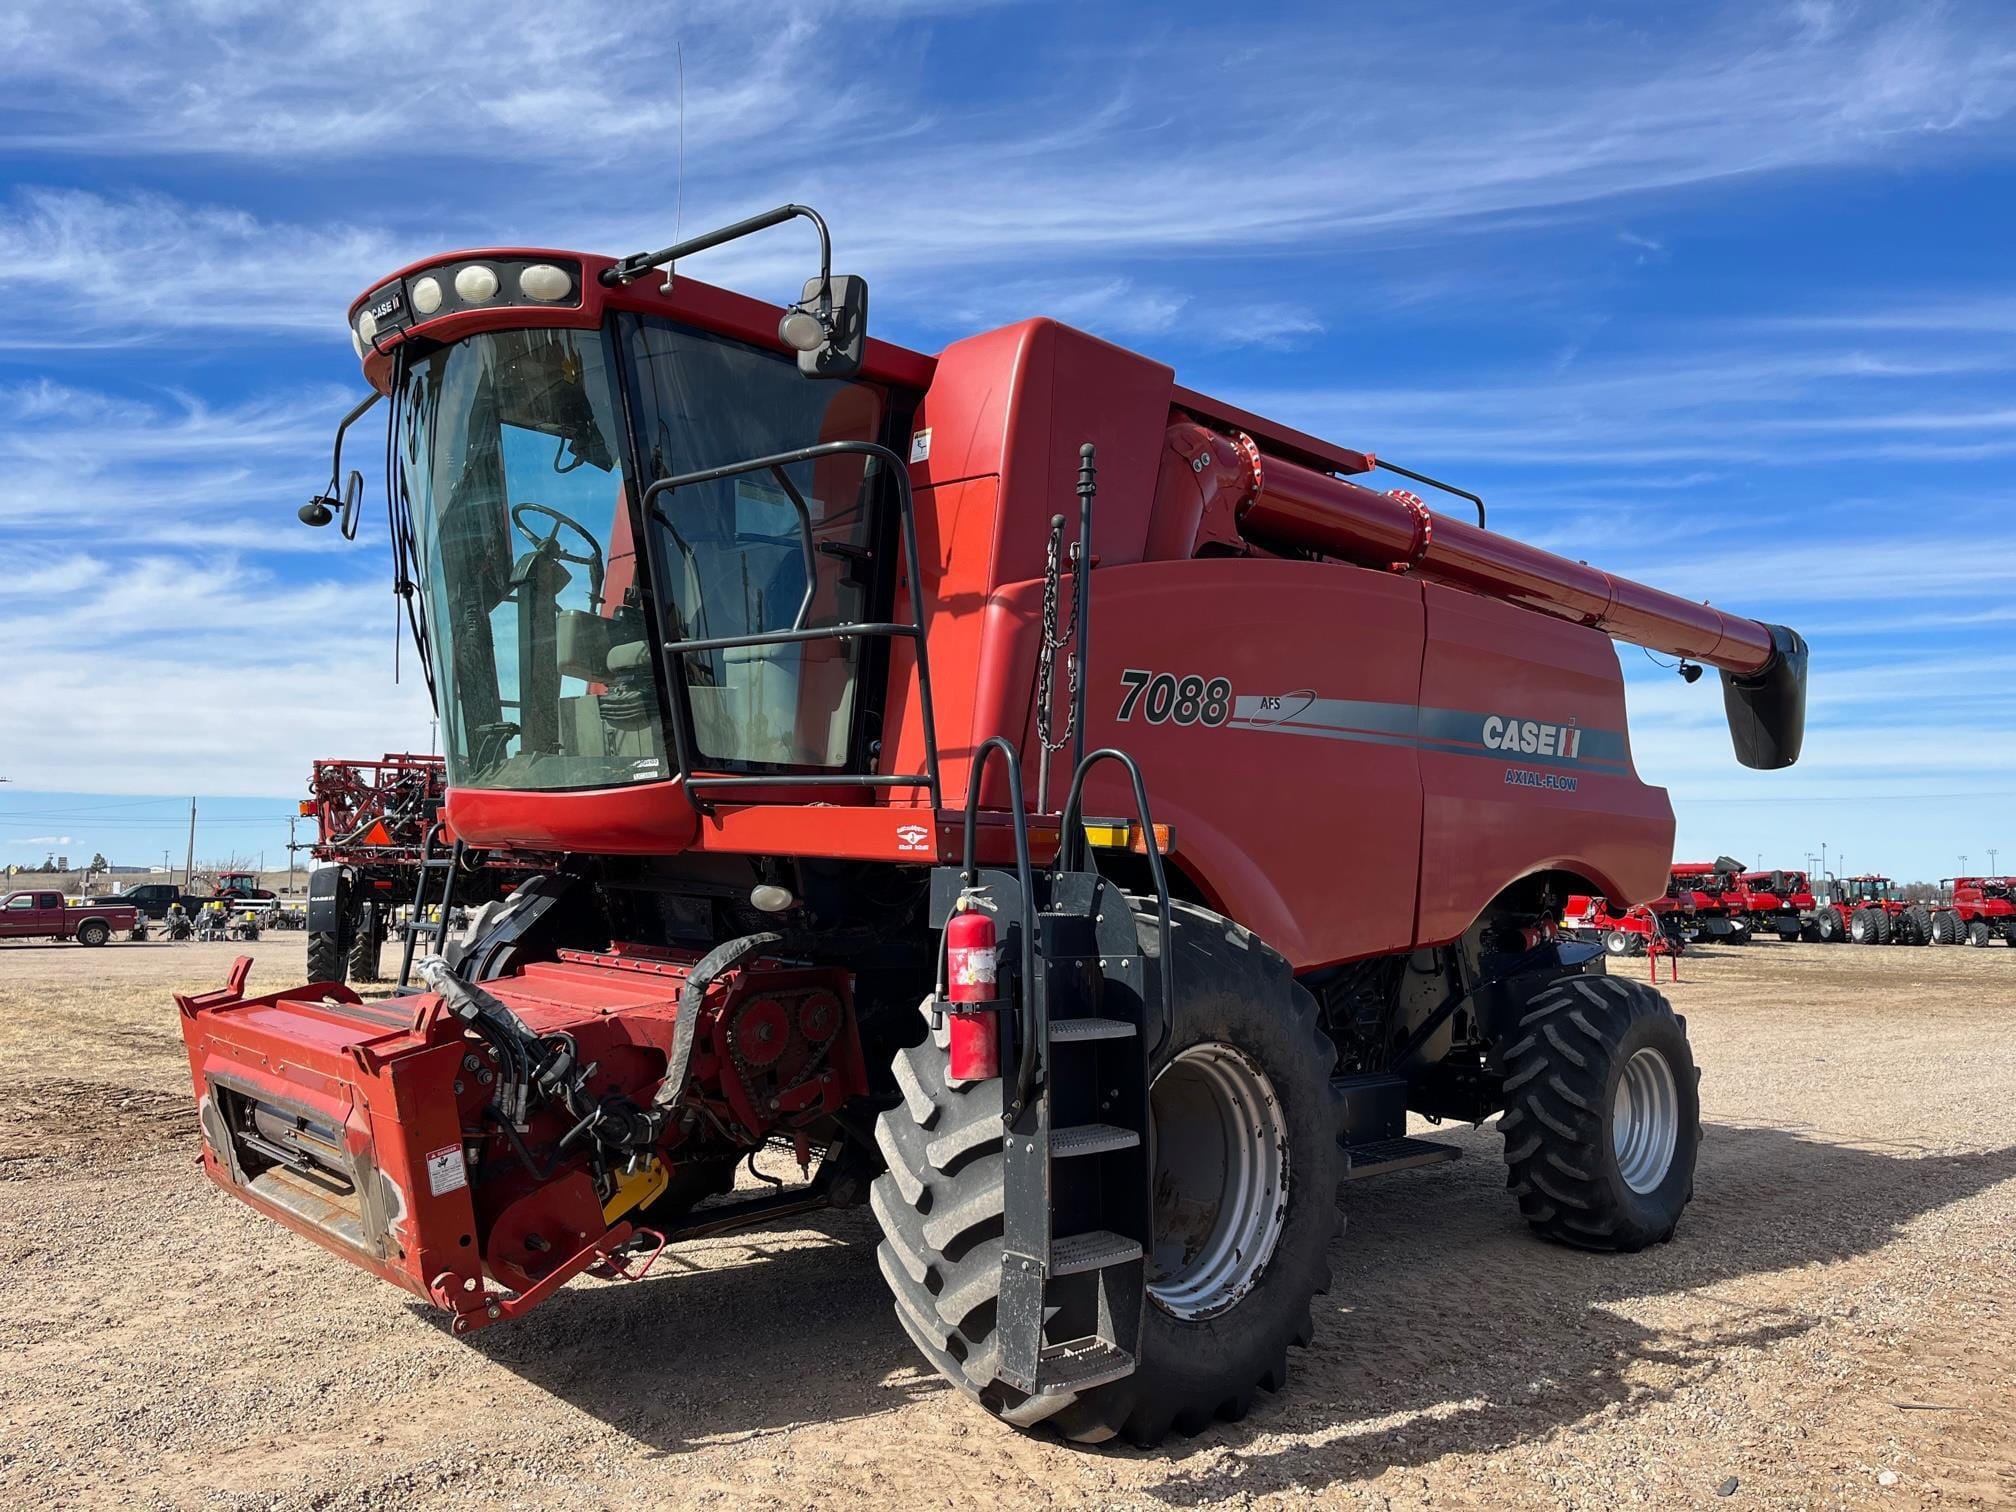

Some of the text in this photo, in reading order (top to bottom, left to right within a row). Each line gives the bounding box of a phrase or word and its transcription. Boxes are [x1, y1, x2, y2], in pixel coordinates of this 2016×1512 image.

[371, 300, 393, 320] CASE
[1116, 668, 1232, 728] 7088
[1259, 696, 1281, 711] AFS
[1482, 715, 1556, 756] CASE
[1504, 768, 1578, 793] AXIAL-FLOW
